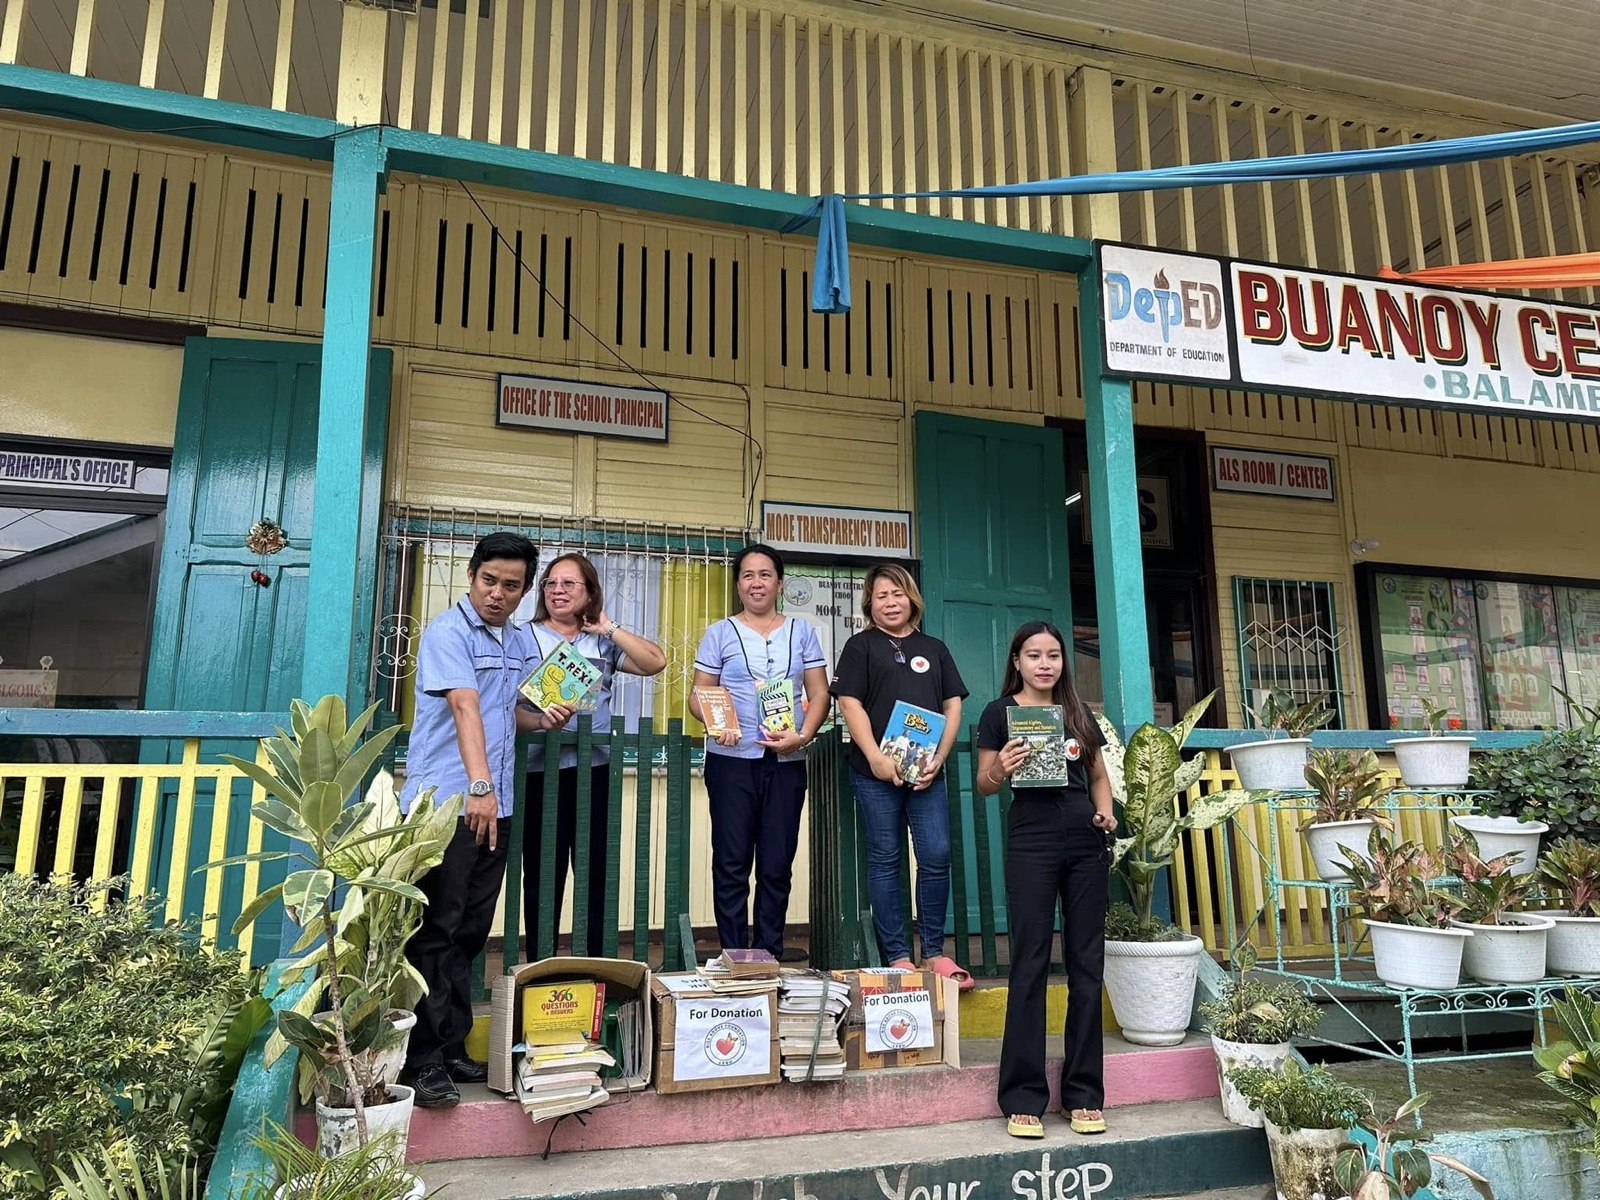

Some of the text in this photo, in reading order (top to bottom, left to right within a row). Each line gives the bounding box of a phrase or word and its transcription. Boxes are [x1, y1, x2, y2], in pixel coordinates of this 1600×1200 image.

[1238, 269, 1600, 382] BUANOY CE
[1109, 341, 1225, 363] DEPARTMENT OF EDUCATION
[502, 385, 664, 429] OFFICE OF THE SCHOOL PRINCIPAL
[0, 453, 129, 485] PRINCIPAL'S OFFICE
[1219, 457, 1329, 490] ALS ROOM / CENTER
[766, 512, 908, 549] MOOE TRANSPARENCY BOARD
[832, 591, 853, 600] CHOO
[558, 652, 593, 687] T. REX!
[541, 1001, 579, 1011] QUESTIONS
[547, 987, 574, 1003] 366
[864, 992, 929, 1007] For Donation
[689, 1008, 763, 1020] For Donation
